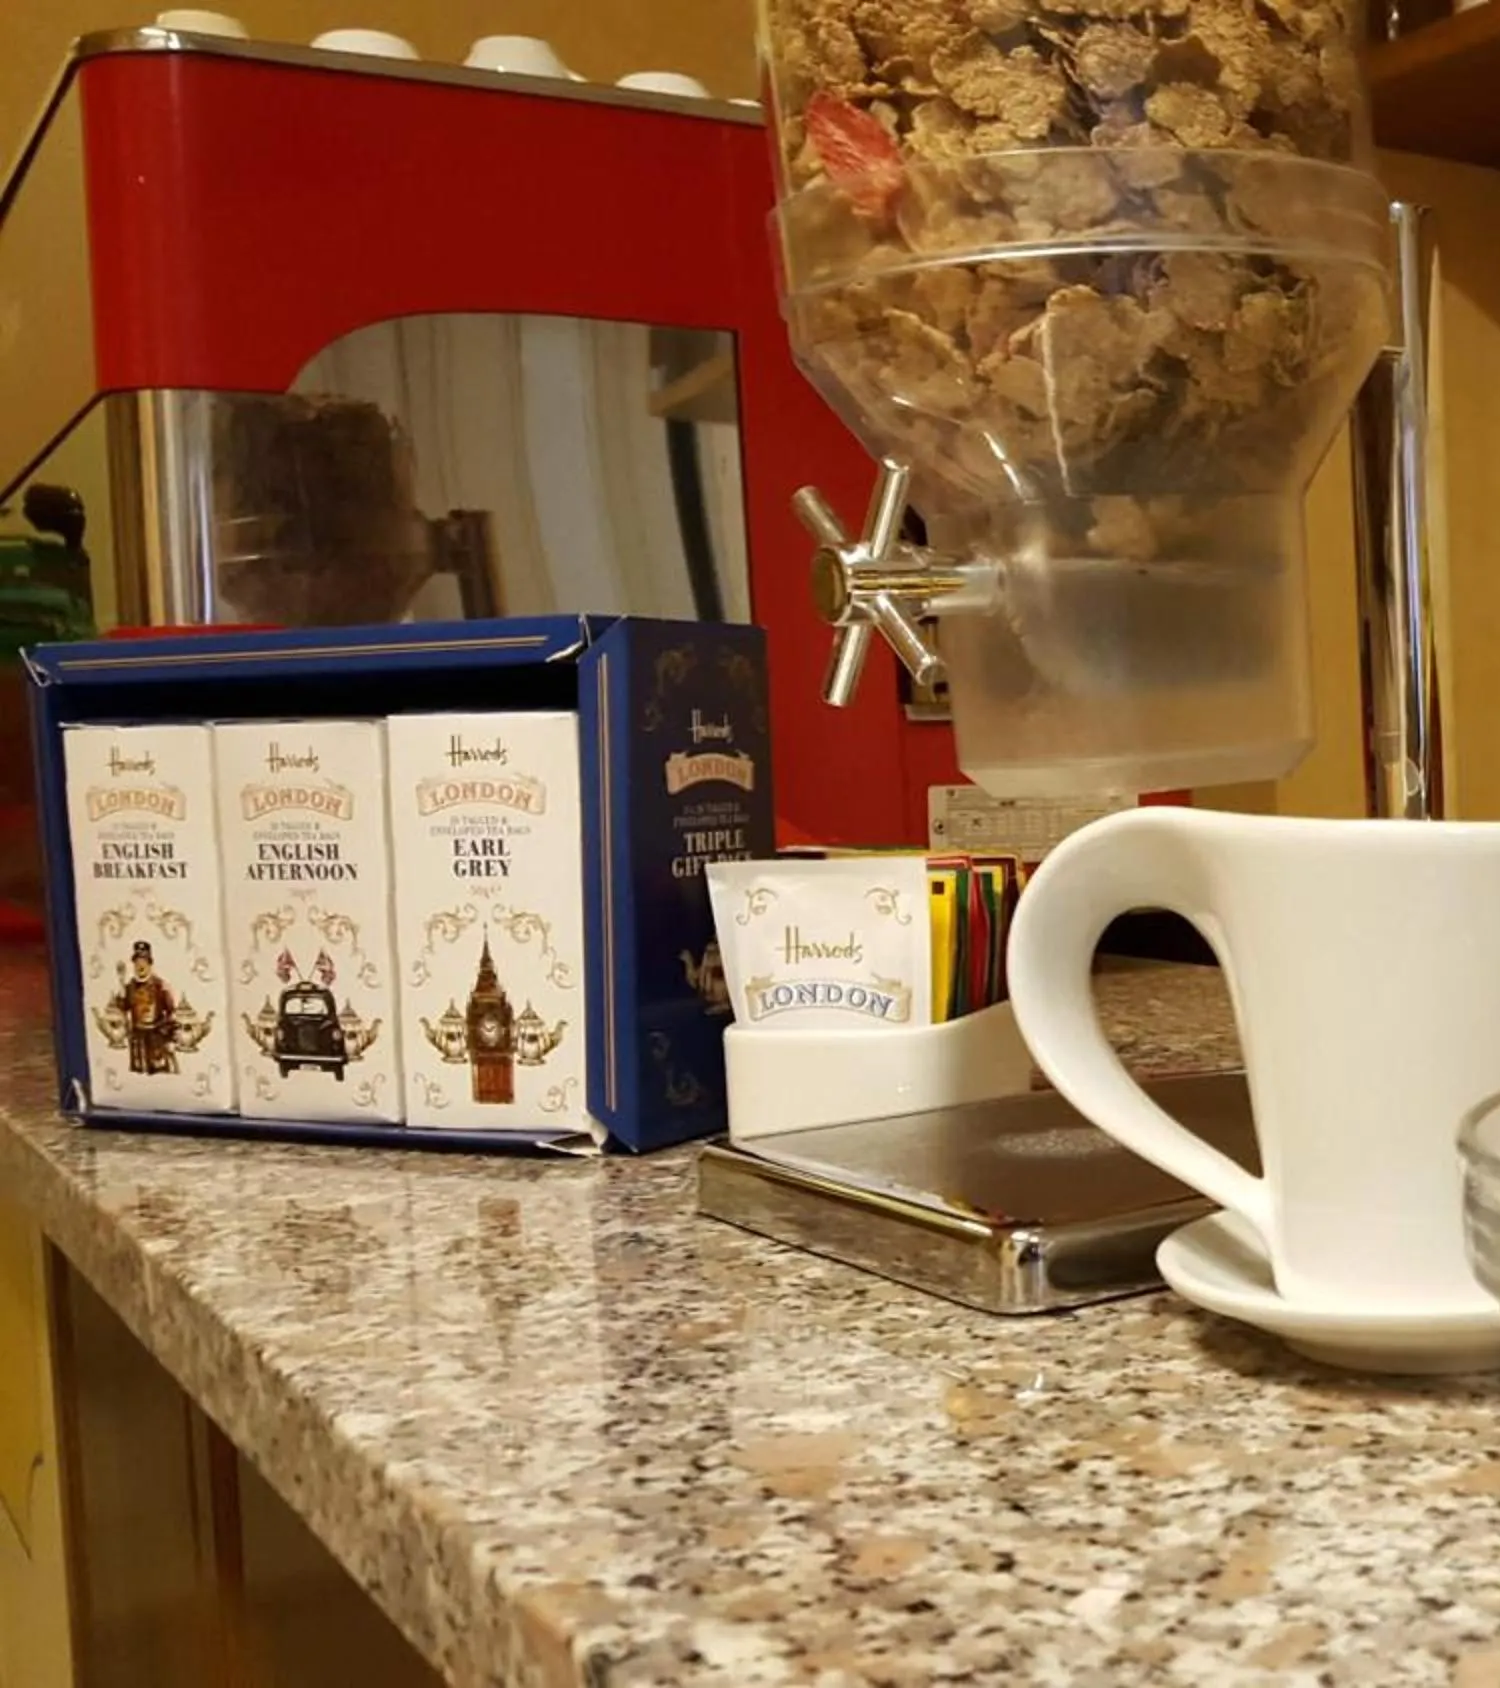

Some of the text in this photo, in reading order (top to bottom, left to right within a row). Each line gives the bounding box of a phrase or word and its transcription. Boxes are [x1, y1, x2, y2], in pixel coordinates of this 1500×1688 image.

[265, 741, 320, 774] Harrods
[444, 735, 509, 767] Harrods
[96, 789, 174, 816] LONDON
[253, 788, 342, 816] LONDON
[430, 781, 532, 812] LONDON
[102, 842, 174, 860] ENGLISH
[258, 843, 339, 861] ENGLISH
[453, 838, 511, 857] EARL
[683, 828, 746, 853] TRIPLE
[93, 862, 188, 879] BREAKFAST
[245, 863, 358, 881] AFTERNOON
[453, 859, 512, 877] GREY
[775, 925, 864, 965] Harrods
[758, 982, 894, 1018] LONDON
